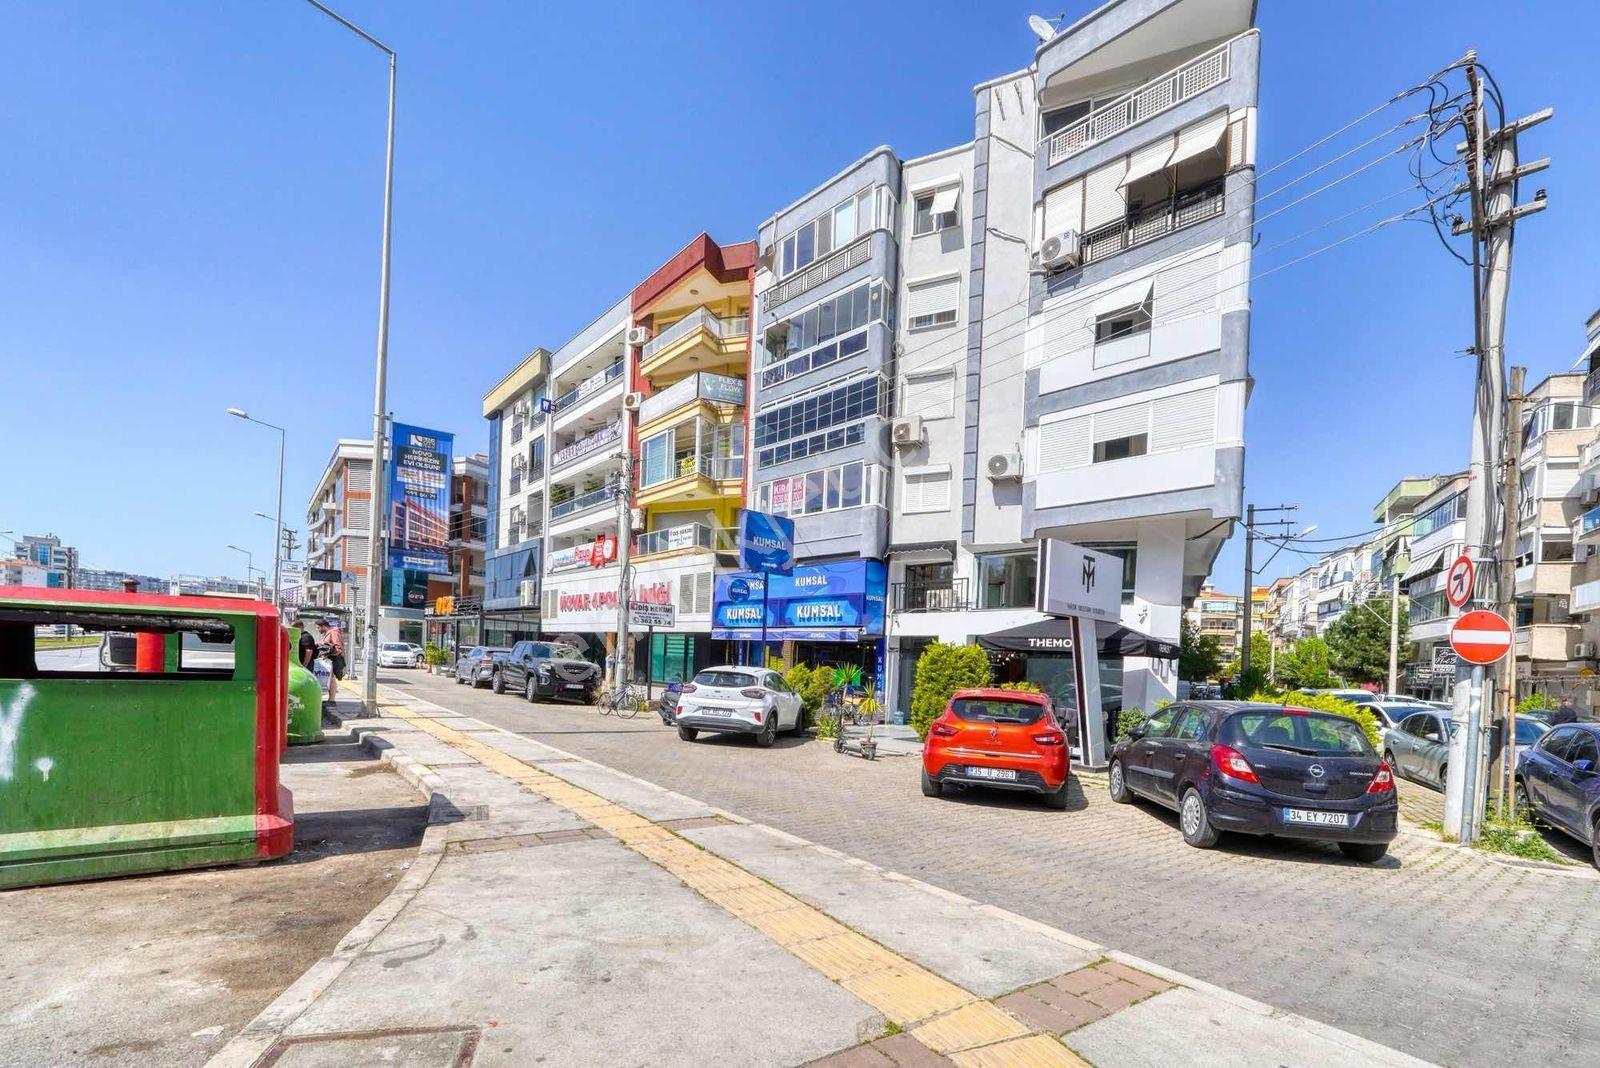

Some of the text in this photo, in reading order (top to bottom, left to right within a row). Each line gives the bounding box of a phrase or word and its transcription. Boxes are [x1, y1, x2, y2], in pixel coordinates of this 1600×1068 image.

[753, 536, 787, 551] KUMSAL
[795, 575, 828, 587] KUMSAL
[726, 607, 763, 620] KUMSAL
[796, 604, 842, 619] KUMSAL
[1290, 810, 1346, 824] 34 EY 7207
